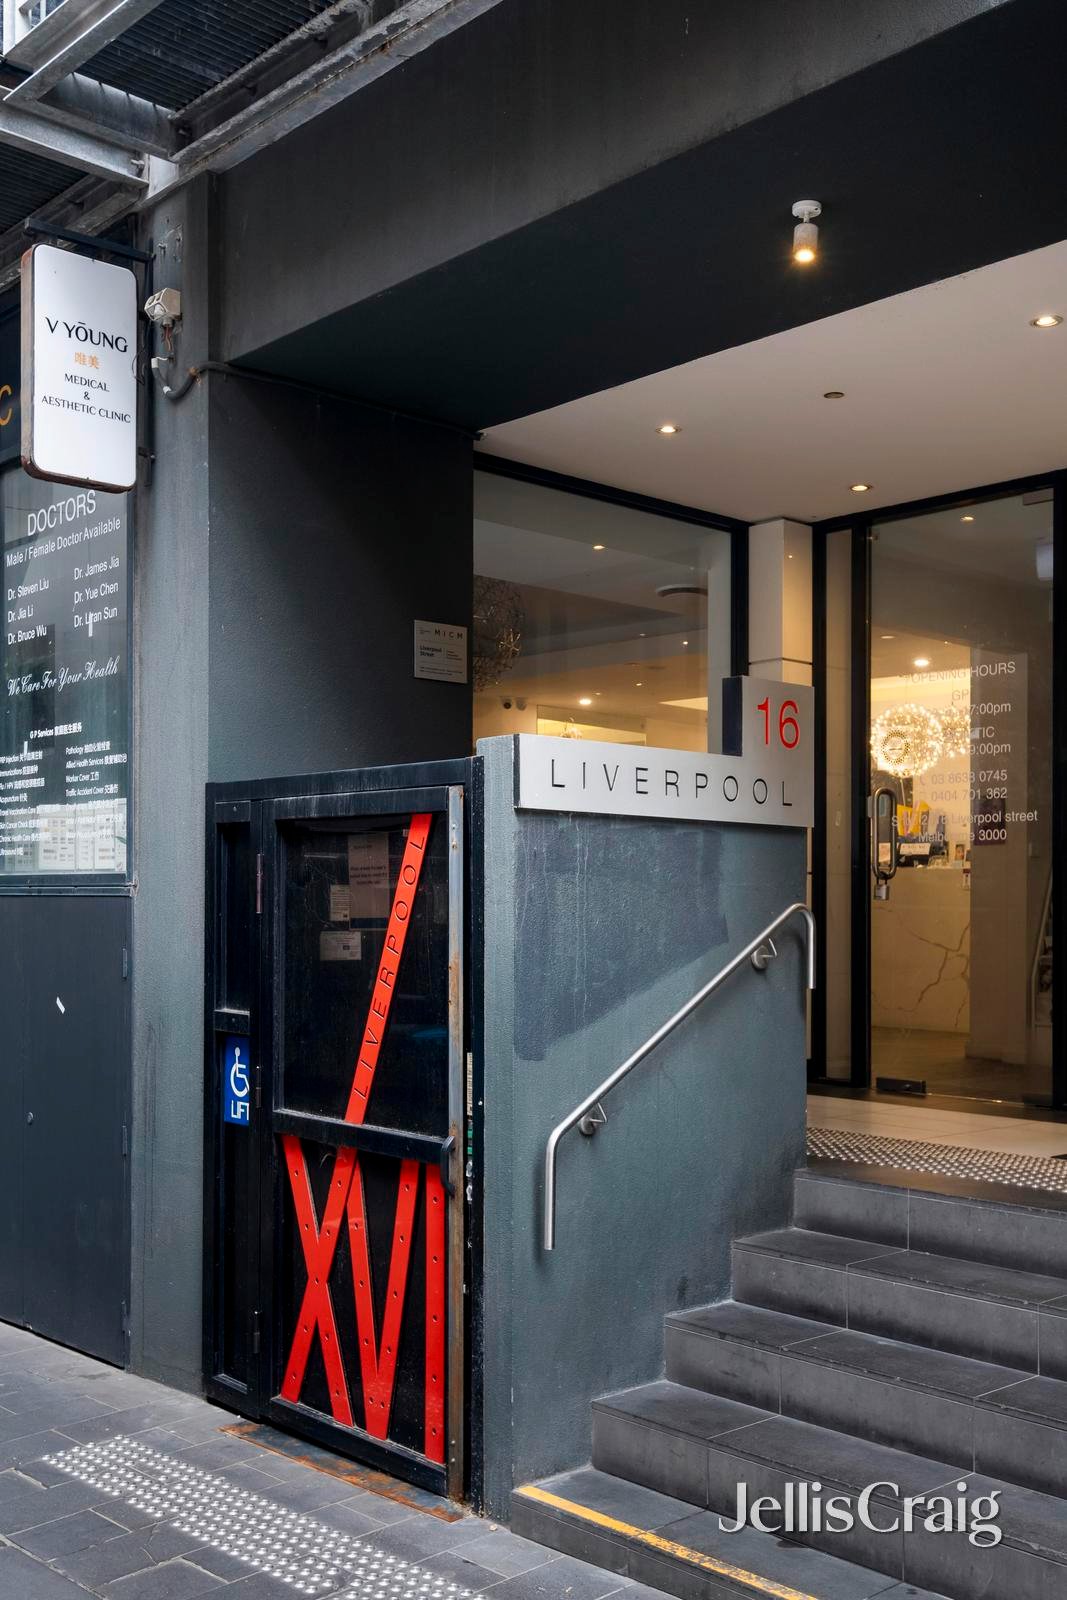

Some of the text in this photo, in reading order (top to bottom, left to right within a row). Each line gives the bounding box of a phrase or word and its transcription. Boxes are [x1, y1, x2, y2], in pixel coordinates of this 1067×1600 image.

[45, 317, 59, 334] V
[64, 373, 110, 392] MEDICAL
[83, 391, 90, 400] &
[41, 395, 131, 423] AESTHETIC CLINIC
[27, 489, 97, 536] DOCTORS
[6, 552, 24, 567] Male
[28, 541, 55, 560] Female
[57, 532, 83, 551] Doctor
[83, 517, 121, 541] Available
[74, 556, 120, 580] Dr. James Jia
[7, 578, 49, 600] Dr. Steven Liu
[74, 582, 119, 604] Dr. Yue Chen
[7, 611, 17, 623] Dr.
[27, 604, 34, 617] Li
[74, 615, 84, 628] Dr.
[103, 606, 118, 620] Sun
[7, 625, 47, 645] Dr. Bruce Wu
[7, 655, 121, 697] We Care For Your Health
[970, 661, 1016, 678] HOURS
[757, 697, 800, 749] 16
[551, 758, 793, 807] LIVERPOOL
[979, 769, 1008, 782] 0745
[986, 787, 1008, 799] 362
[1005, 809, 1039, 822] street
[978, 829, 1007, 841] 3000
[353, 836, 426, 1101] LIVERPOOL
